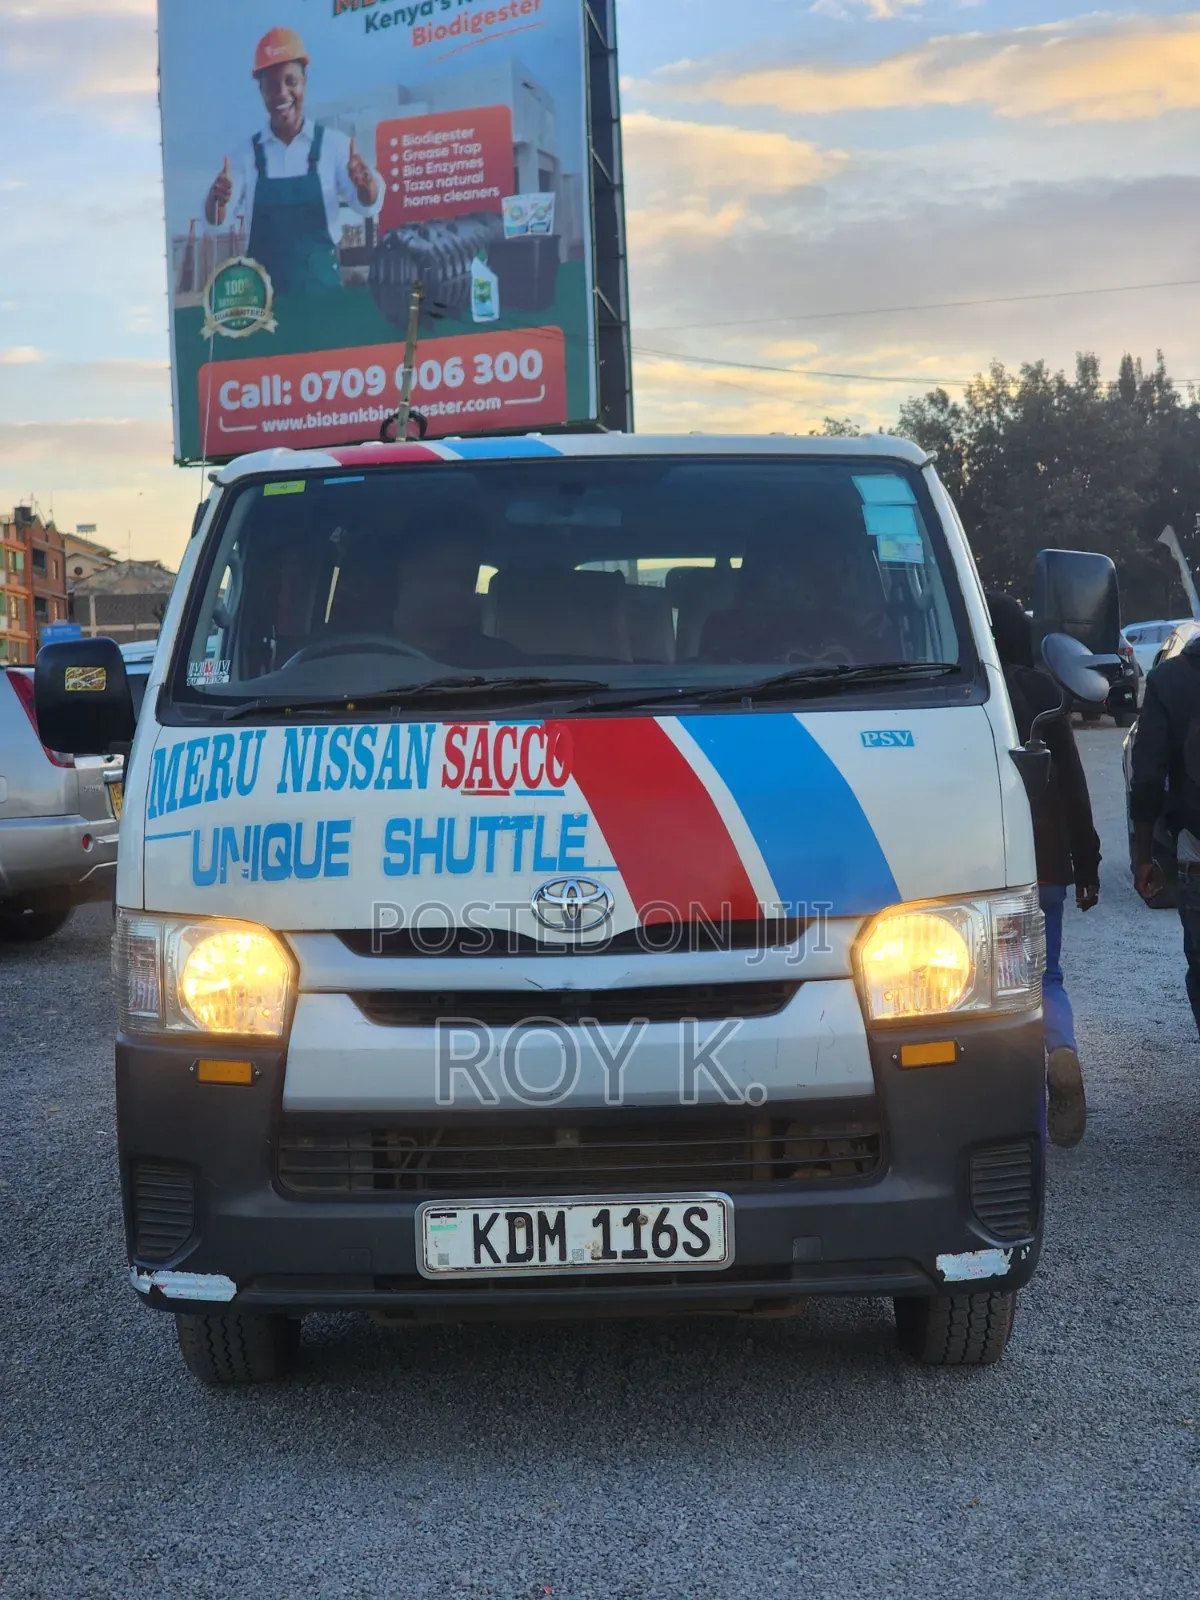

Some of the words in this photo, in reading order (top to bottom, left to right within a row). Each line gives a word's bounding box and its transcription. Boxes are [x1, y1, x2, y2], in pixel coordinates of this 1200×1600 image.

[411, 0, 544, 48] Biodigester
[402, 128, 475, 147] Biodigester
[403, 145, 450, 162] Grease
[452, 143, 482, 158] Trap
[403, 164, 424, 177] Bio
[425, 157, 484, 177] Enzymes
[435, 171, 484, 189] natural
[403, 193, 441, 208] home
[443, 185, 500, 203] cleaners
[219, 375, 292, 410] Call:
[300, 365, 386, 401] 0709
[472, 349, 543, 386] 300
[862, 731, 912, 747] PSV
[148, 730, 266, 820] MERU
[277, 724, 435, 793] NISSAN
[441, 723, 573, 789] SACCO
[191, 819, 352, 887] UNIQUE
[383, 813, 589, 877] SHUTTLE
[471, 1210, 567, 1264] KDM
[591, 1205, 712, 1260] 116S
